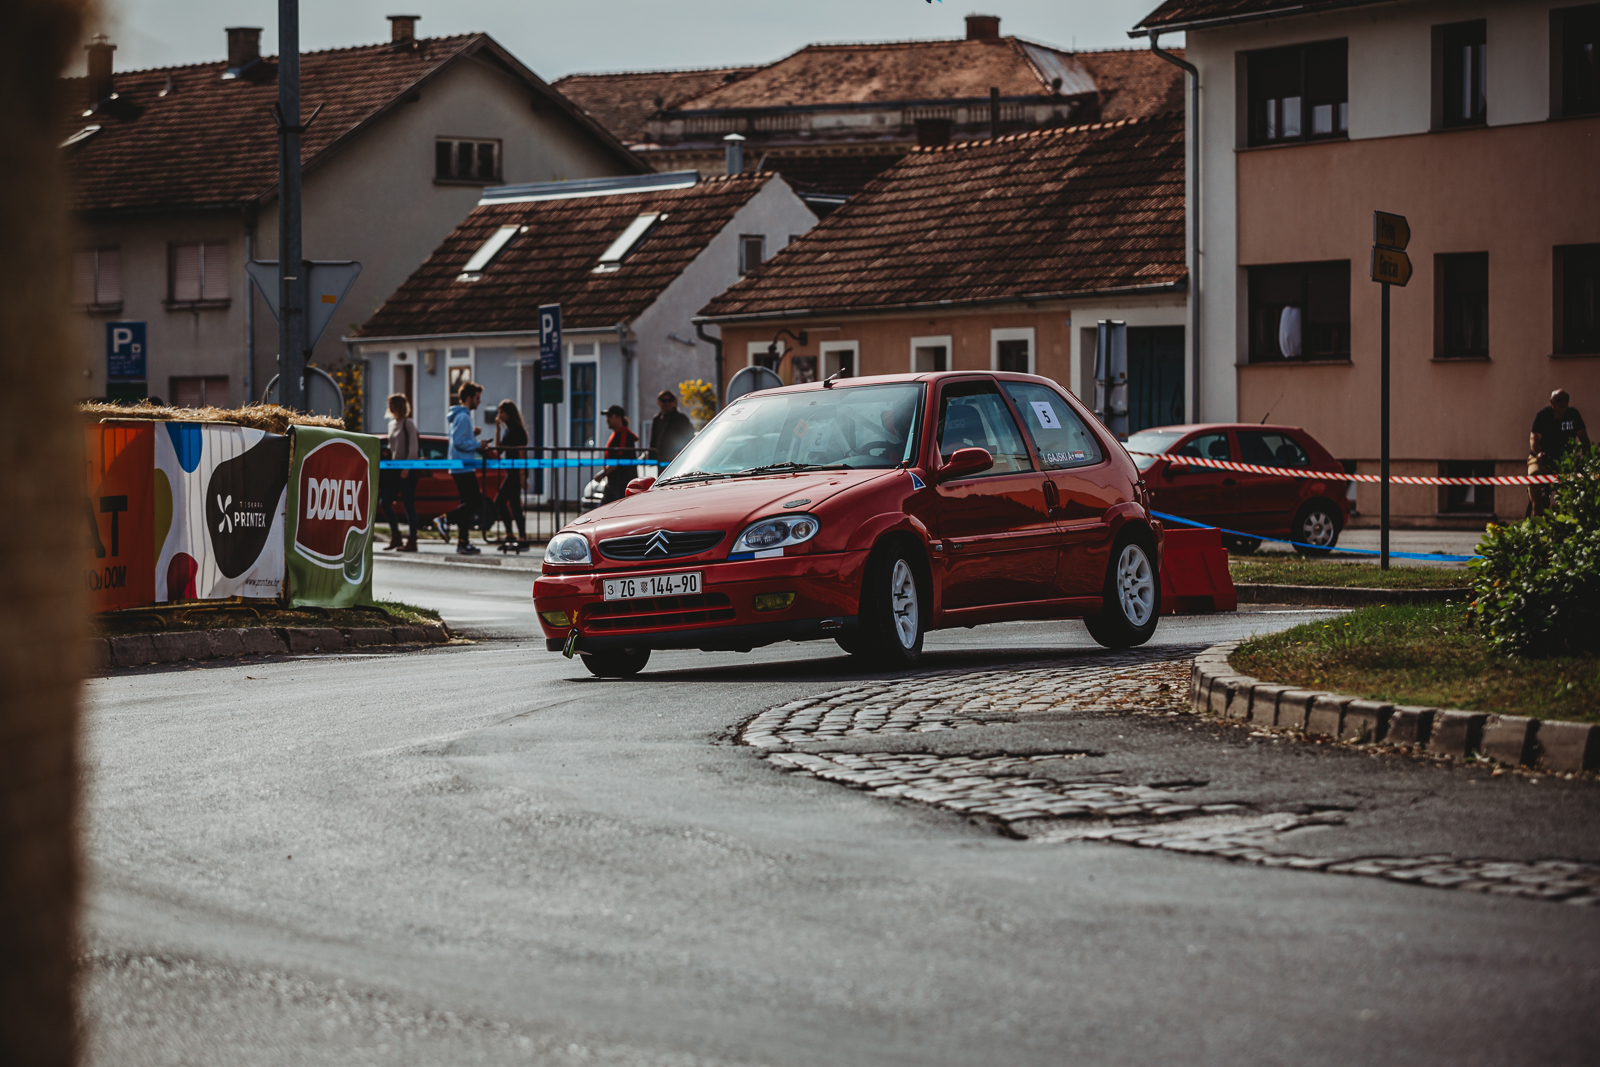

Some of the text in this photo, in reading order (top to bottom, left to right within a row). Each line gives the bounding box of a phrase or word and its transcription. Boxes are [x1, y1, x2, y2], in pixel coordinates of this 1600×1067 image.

[113, 327, 133, 354] P
[542, 314, 553, 344] P
[1042, 410, 1051, 423] 5
[306, 477, 363, 521] DODLEX
[234, 511, 267, 528] PRINTEX
[104, 565, 127, 589] DOM
[607, 575, 697, 598] 3 ZG 144-90
